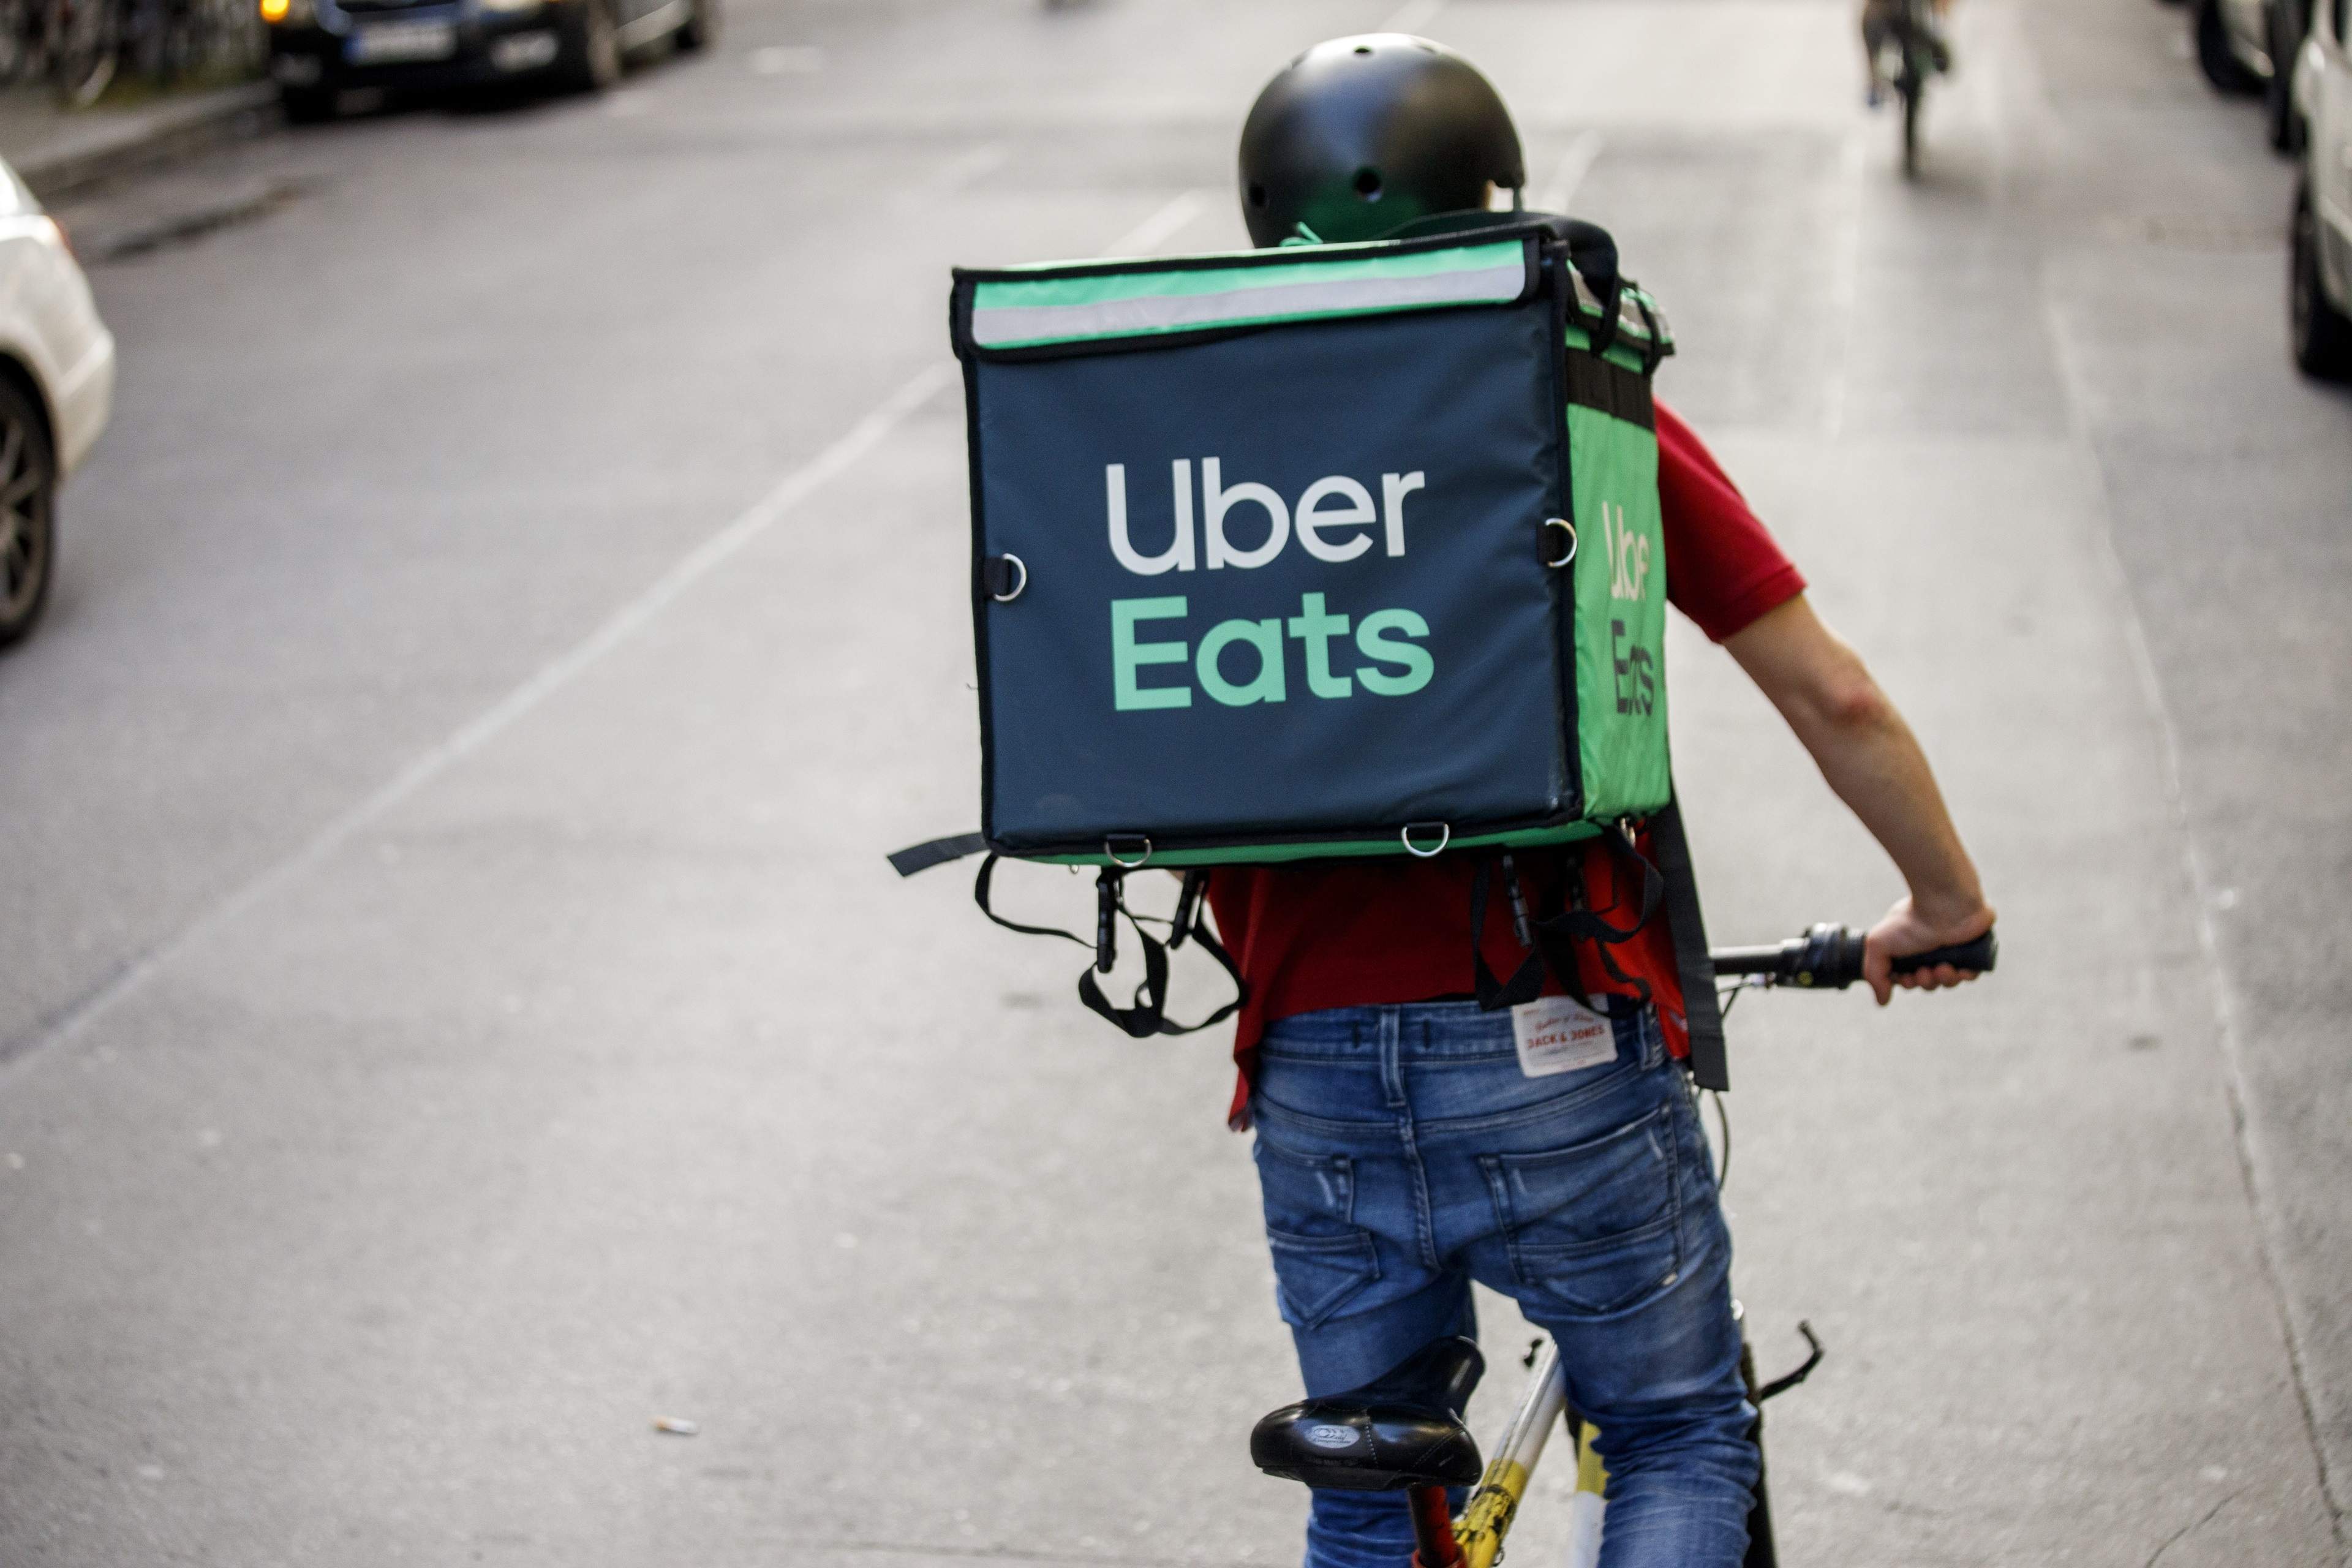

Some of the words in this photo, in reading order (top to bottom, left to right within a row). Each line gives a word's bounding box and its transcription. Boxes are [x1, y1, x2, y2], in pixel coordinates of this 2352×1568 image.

[1106, 456, 1425, 575] Uber
[1110, 592, 1434, 712] Eats
[1527, 1033, 1556, 1049] JACK
[1571, 1023, 1605, 1041] JONES
